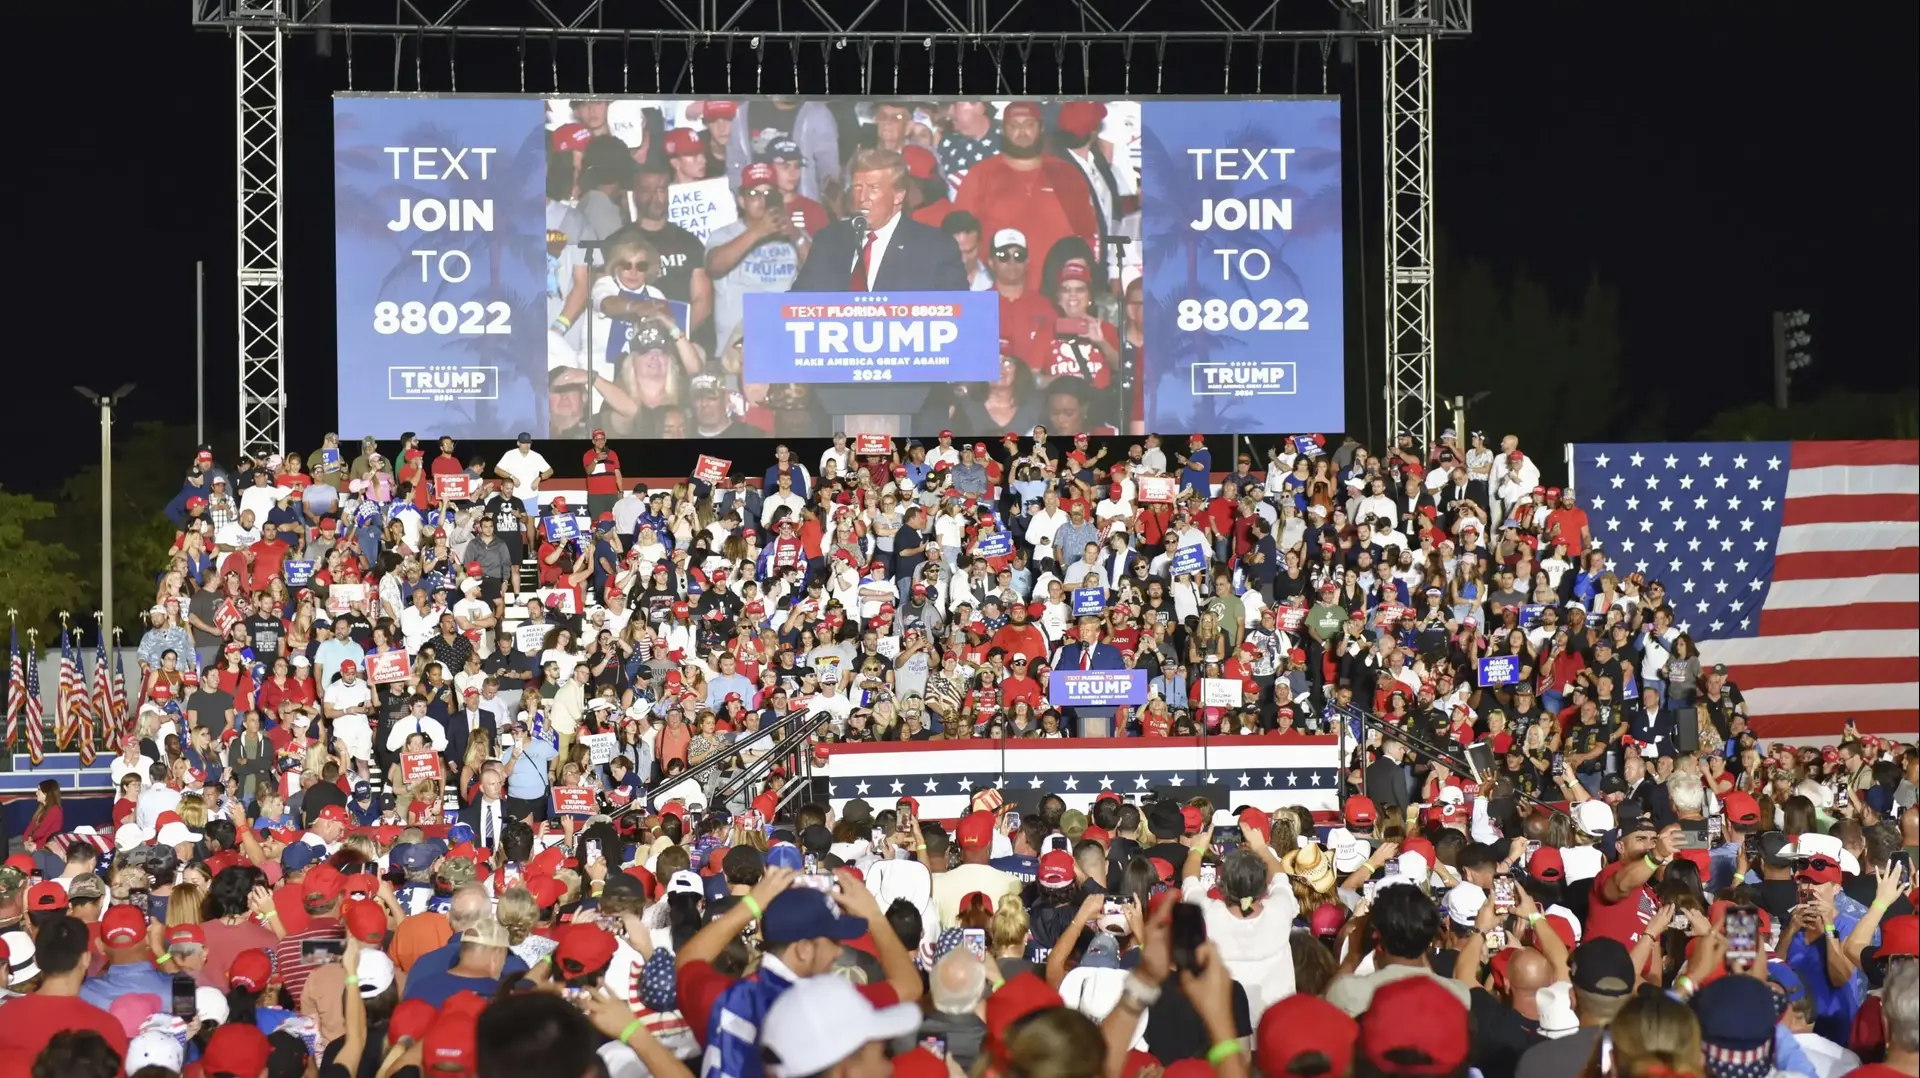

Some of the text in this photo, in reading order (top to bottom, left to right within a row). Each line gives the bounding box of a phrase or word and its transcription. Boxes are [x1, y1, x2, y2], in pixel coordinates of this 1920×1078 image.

[384, 147, 496, 180] TEXT
[1187, 148, 1296, 180] TEXT
[672, 191, 702, 204] AKE
[387, 199, 494, 232] JOIN
[667, 202, 716, 218] ERICA
[1190, 198, 1292, 231] JOIN
[673, 216, 708, 229] EAT
[412, 250, 471, 283] TO
[744, 262, 794, 276] TRUMP
[1213, 248, 1271, 281] TO
[373, 302, 512, 334] 88022
[790, 305, 953, 317] TEXT FLORIDA TO 88022
[1177, 298, 1309, 332] 88022
[786, 320, 958, 353] TRUMP
[795, 357, 824, 366] MAKE
[827, 357, 874, 366] AMERICA
[877, 357, 910, 366] GREAT
[401, 372, 486, 388] TRUMP
[853, 369, 892, 380] 2024
[1204, 368, 1284, 383] TRUMP
[374, 671, 405, 680] COUNTRY
[1066, 681, 1132, 694] TRUMP
